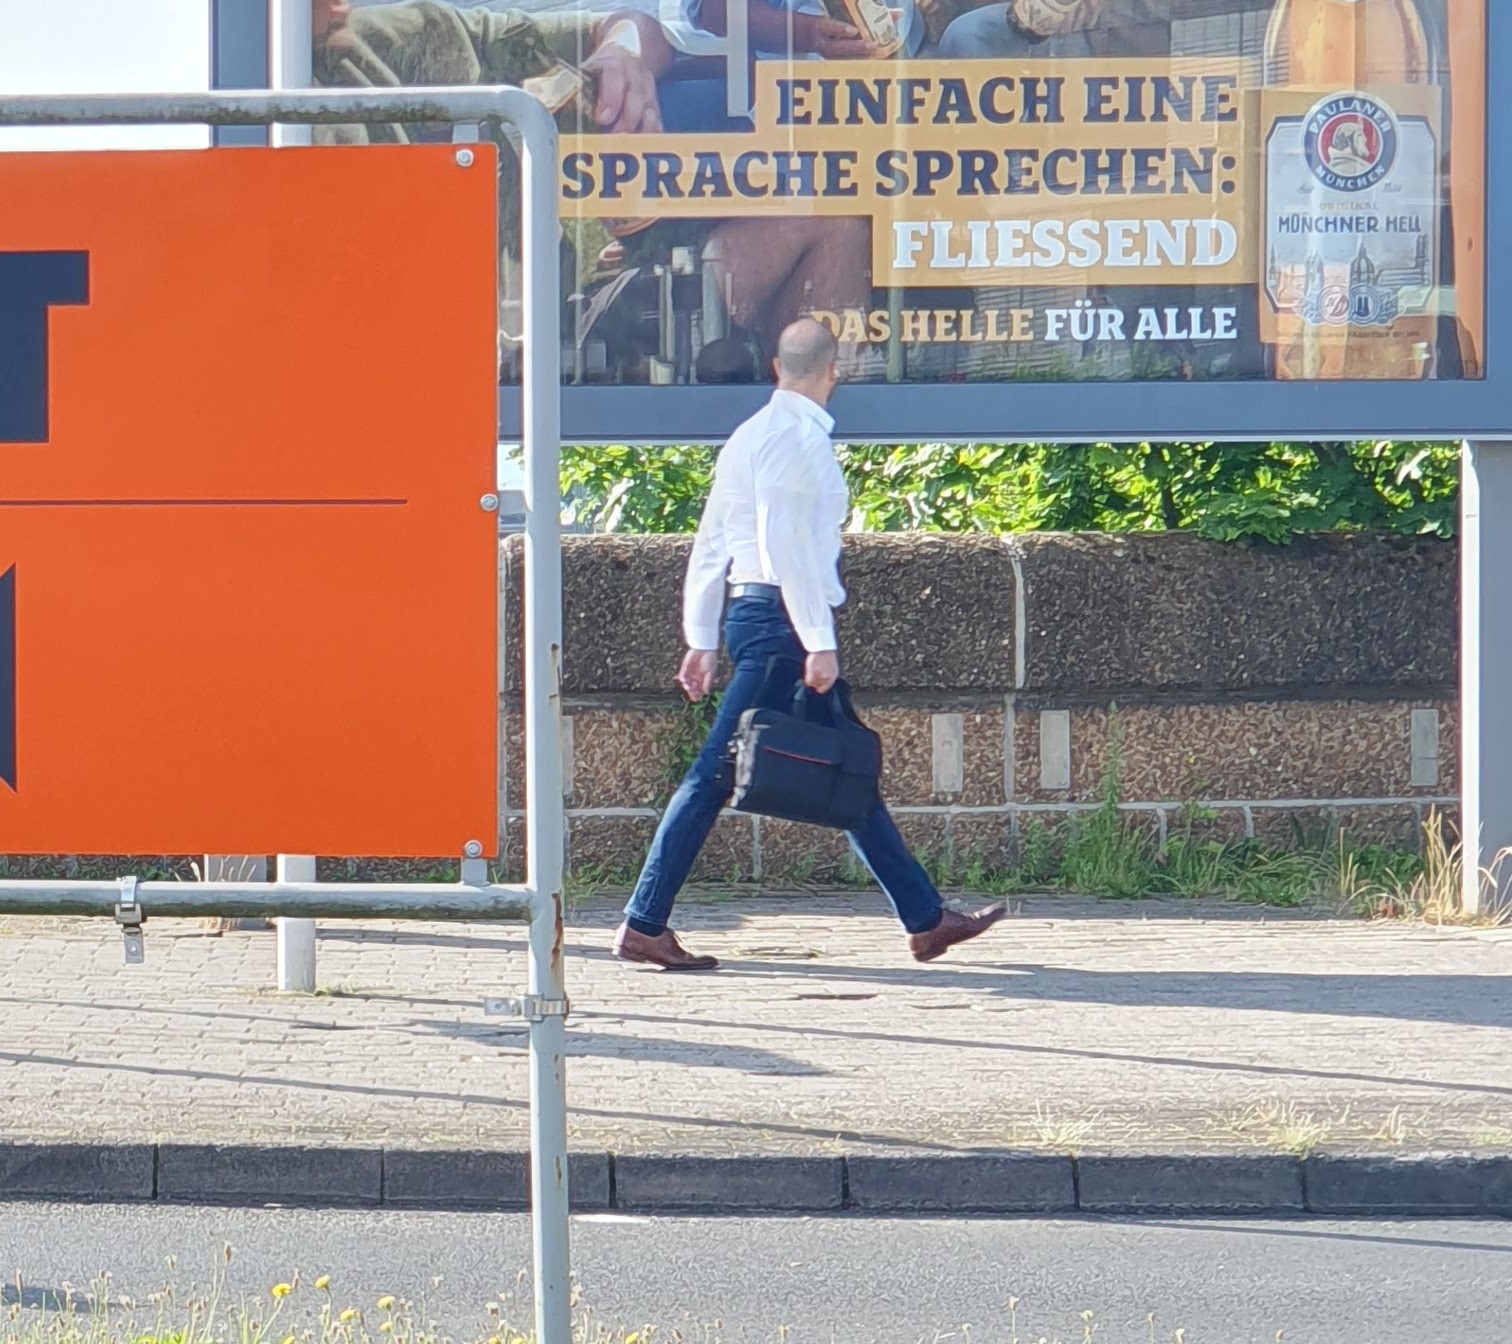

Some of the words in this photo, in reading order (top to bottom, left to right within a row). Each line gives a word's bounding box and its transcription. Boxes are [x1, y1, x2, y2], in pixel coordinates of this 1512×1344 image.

[775, 76, 1066, 125] EINFACH
[1082, 75, 1238, 124] EINE
[1309, 99, 1392, 134] PAULANER
[561, 150, 858, 199] SPRACHE
[874, 146, 1237, 197] SPRECHEN:
[892, 217, 1238, 269] FLIESSEND
[1278, 212, 1380, 233] MÜNCHNER
[1385, 215, 1422, 233] HELL
[810, 309, 891, 343] DAS
[898, 308, 1034, 342] HELLE
[1044, 299, 1127, 342] FÜR
[1133, 306, 1238, 341] ALLE
